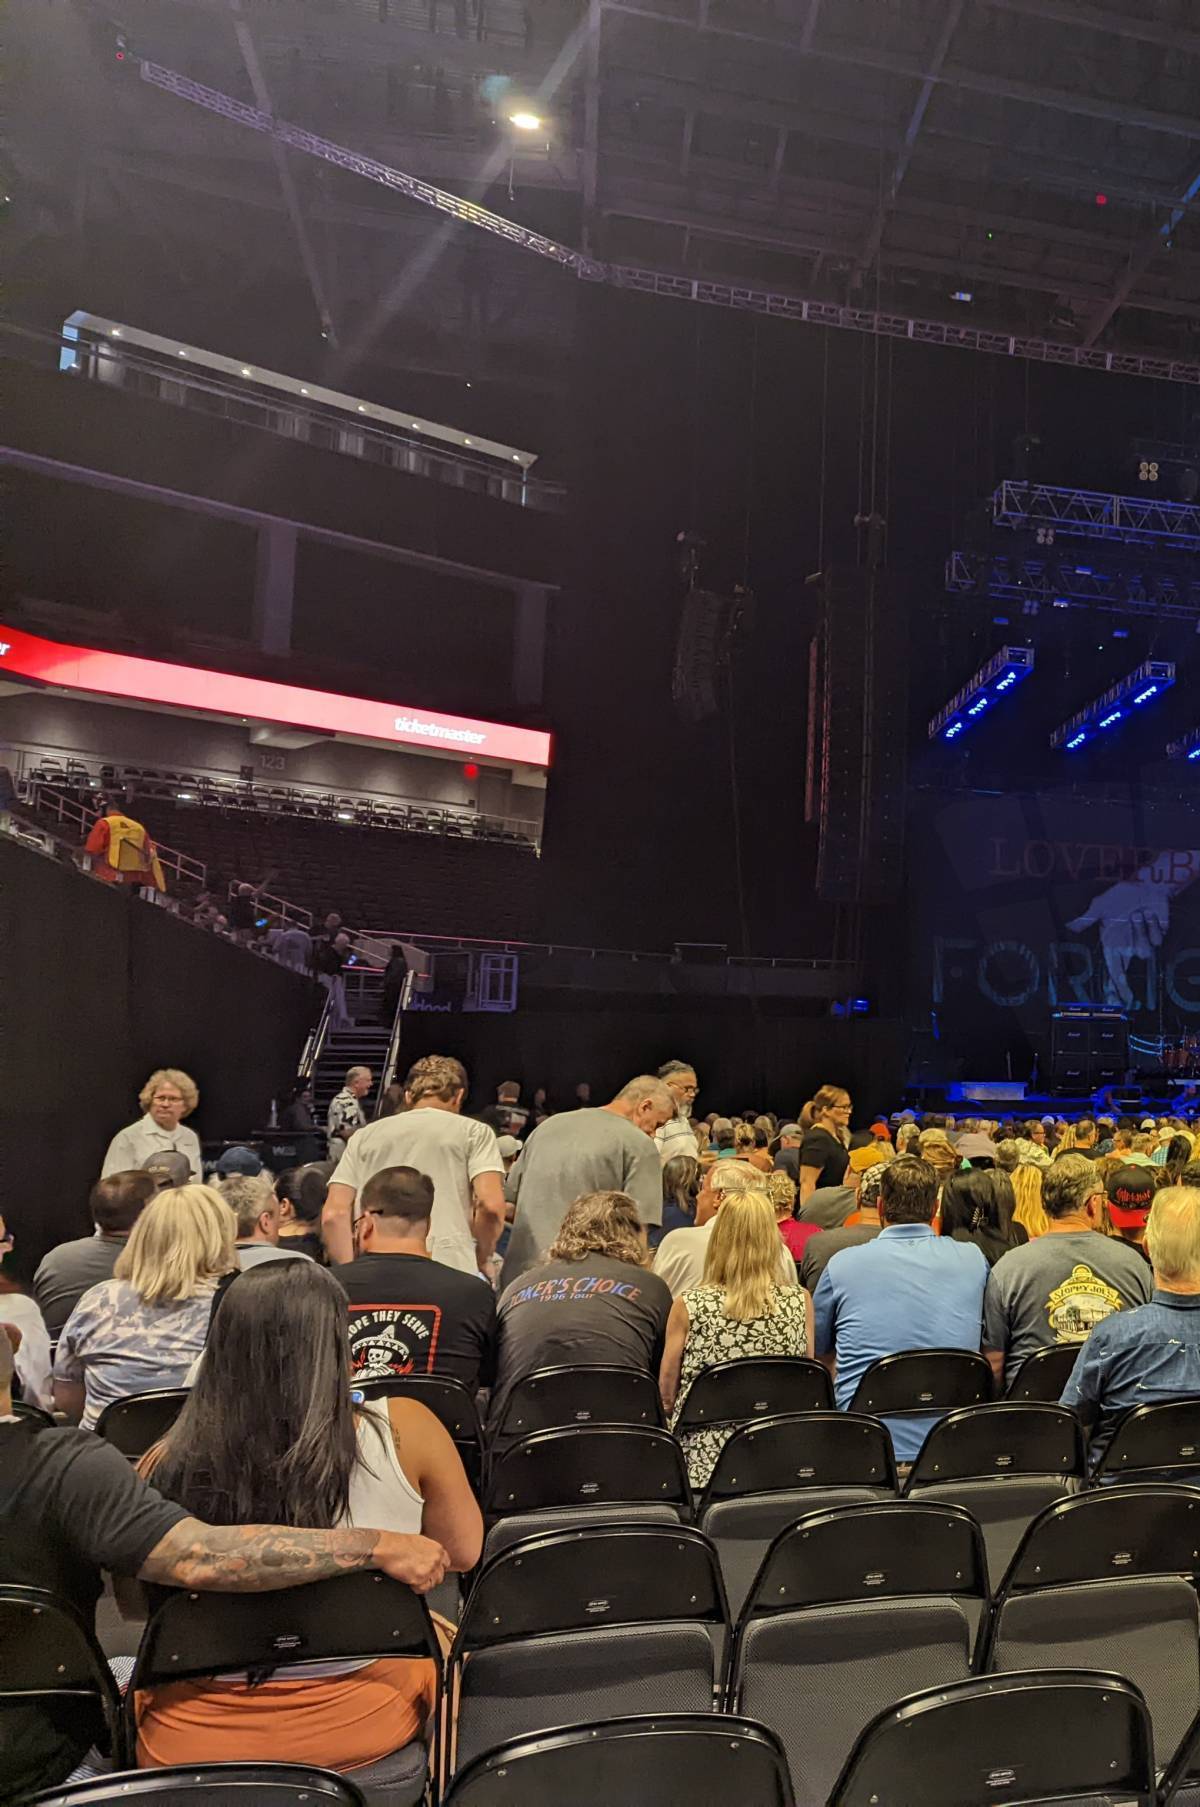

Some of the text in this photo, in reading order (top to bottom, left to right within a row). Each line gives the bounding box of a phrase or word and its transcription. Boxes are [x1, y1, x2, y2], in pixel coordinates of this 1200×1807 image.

[395, 717, 486, 745] ticketmaster
[260, 754, 286, 770] 123
[540, 1293, 566, 1302] 1996
[573, 1277, 642, 1302] CHOICE
[1053, 1285, 1087, 1300] SLOPPY
[372, 1310, 401, 1323] THEY
[401, 1313, 429, 1340] SERVE
